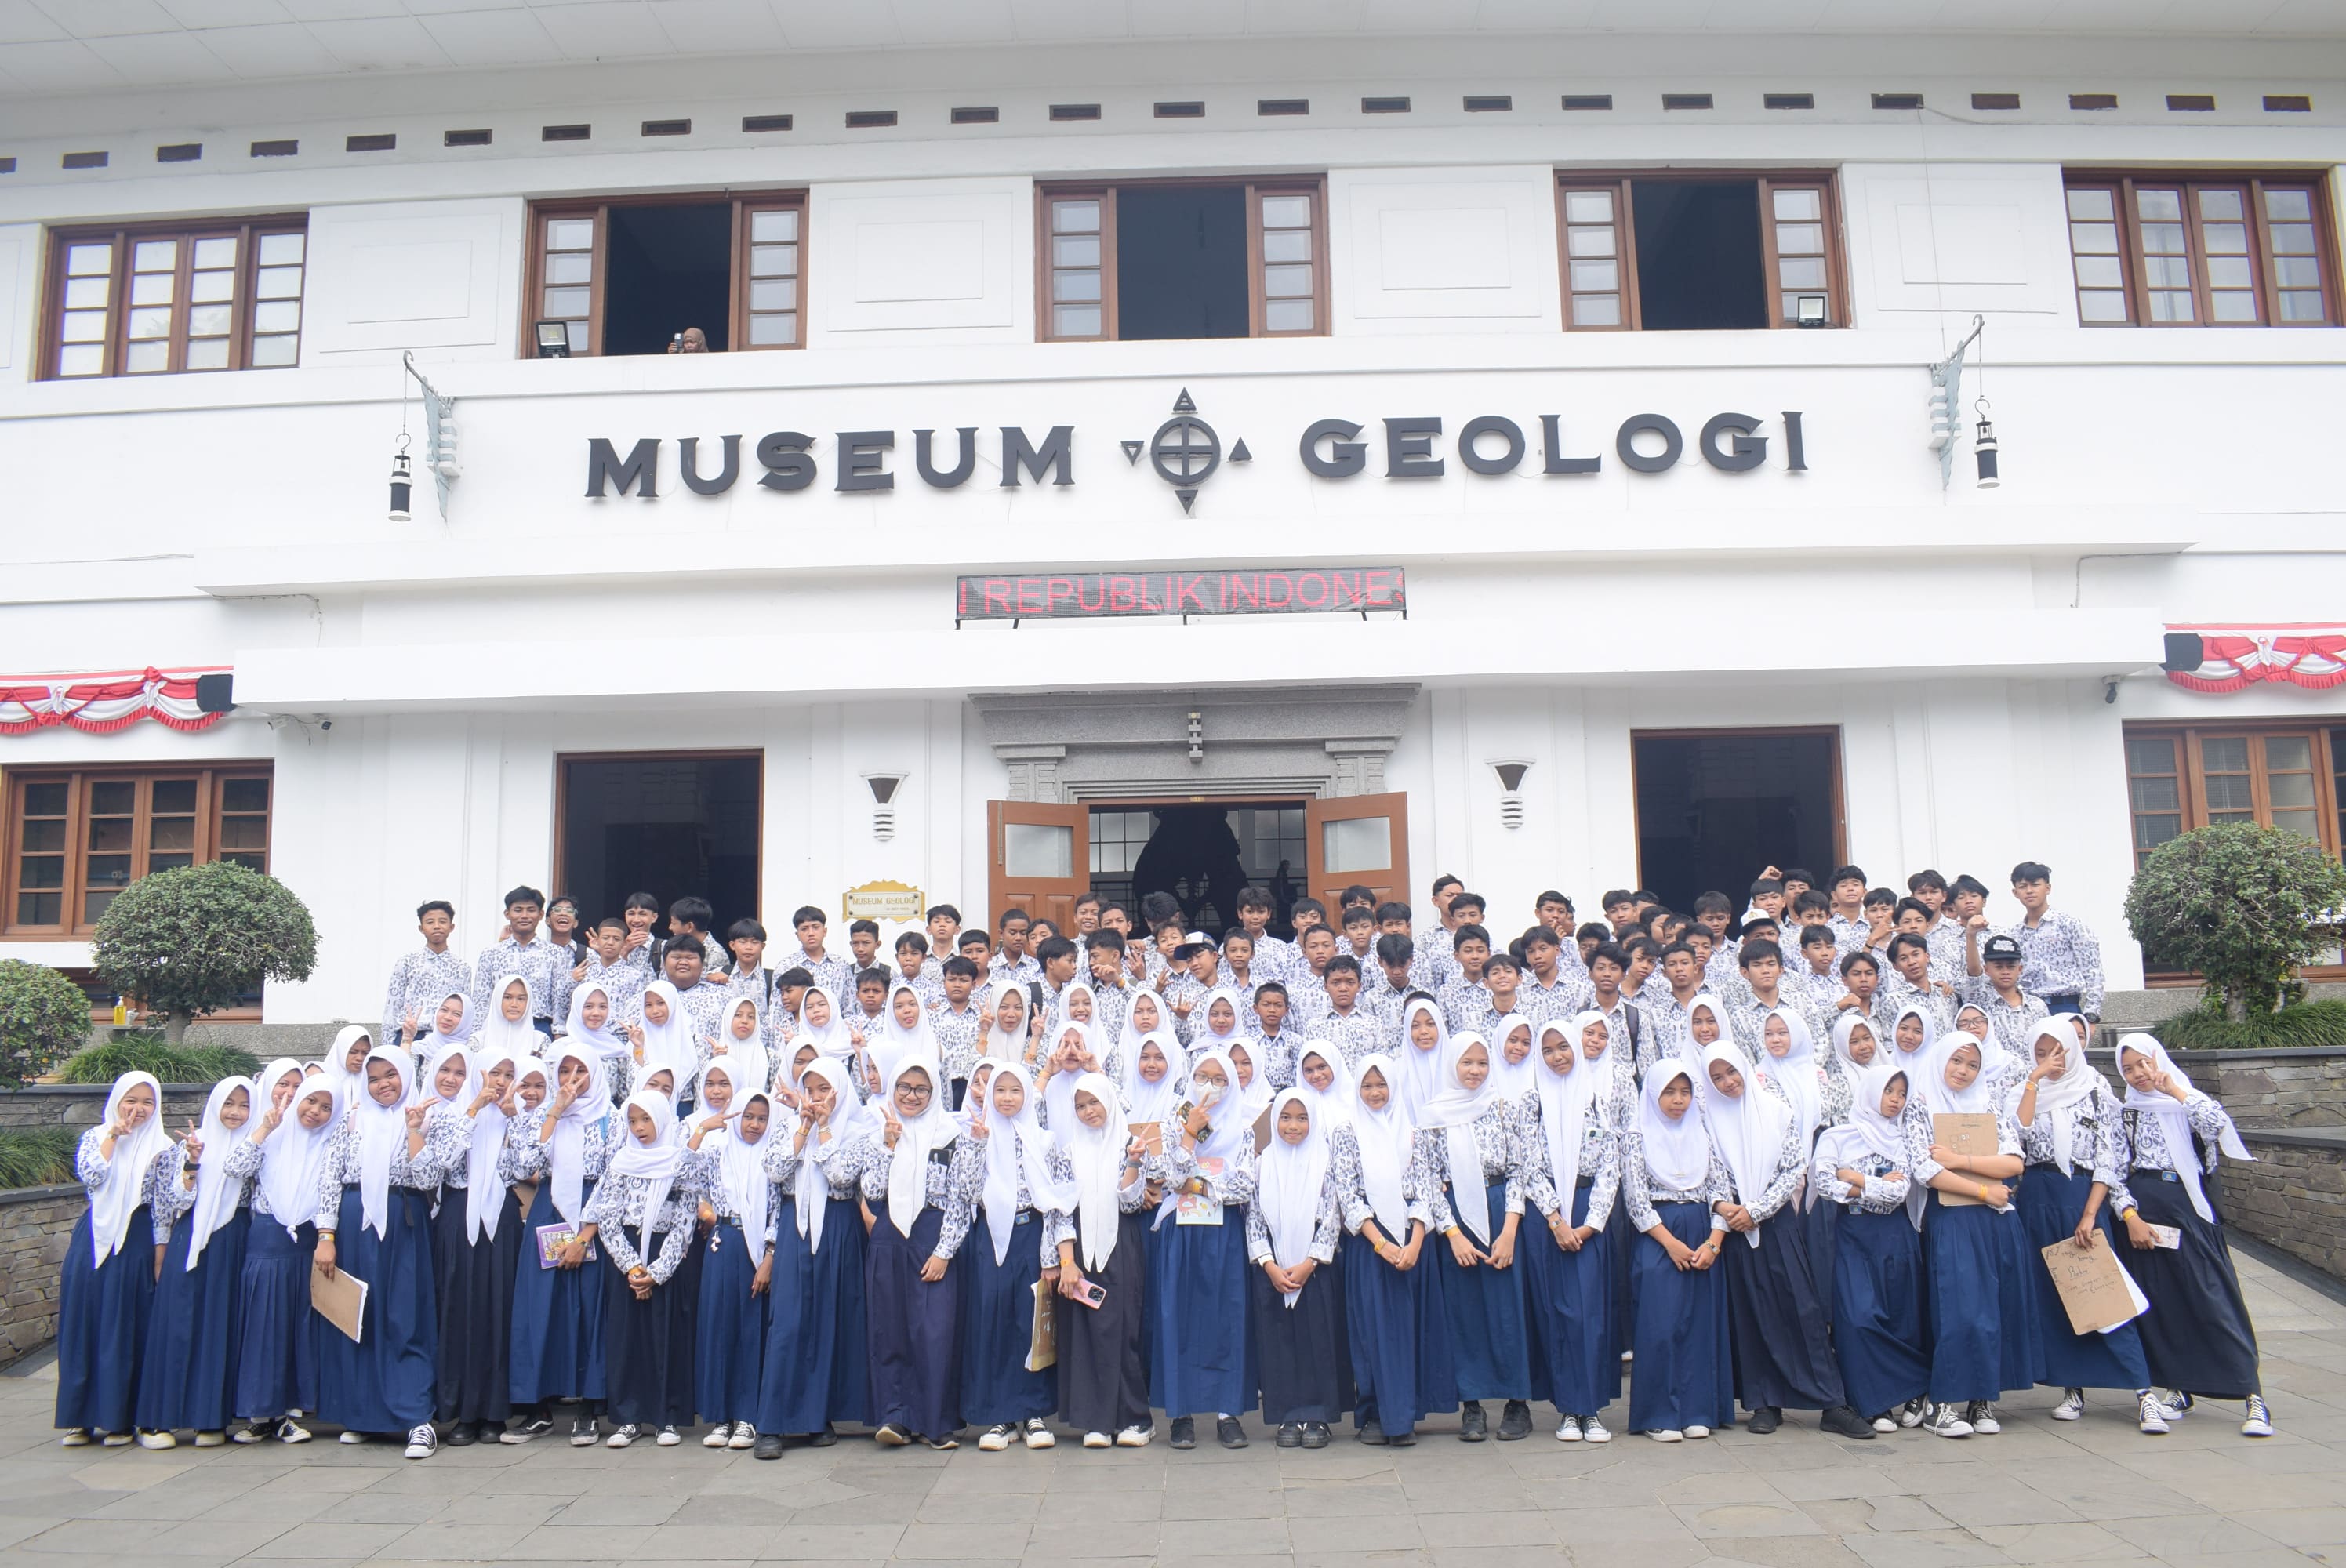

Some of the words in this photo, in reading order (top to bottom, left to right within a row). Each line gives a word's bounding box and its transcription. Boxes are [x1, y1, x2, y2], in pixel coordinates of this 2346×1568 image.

[584, 425, 1076, 498] MUSEUM
[1299, 411, 1809, 477] GEOLOGI
[984, 575, 1205, 614] REPUBLIK
[1221, 572, 1404, 609] INDONE
[886, 896, 916, 905] GEOLOGI
